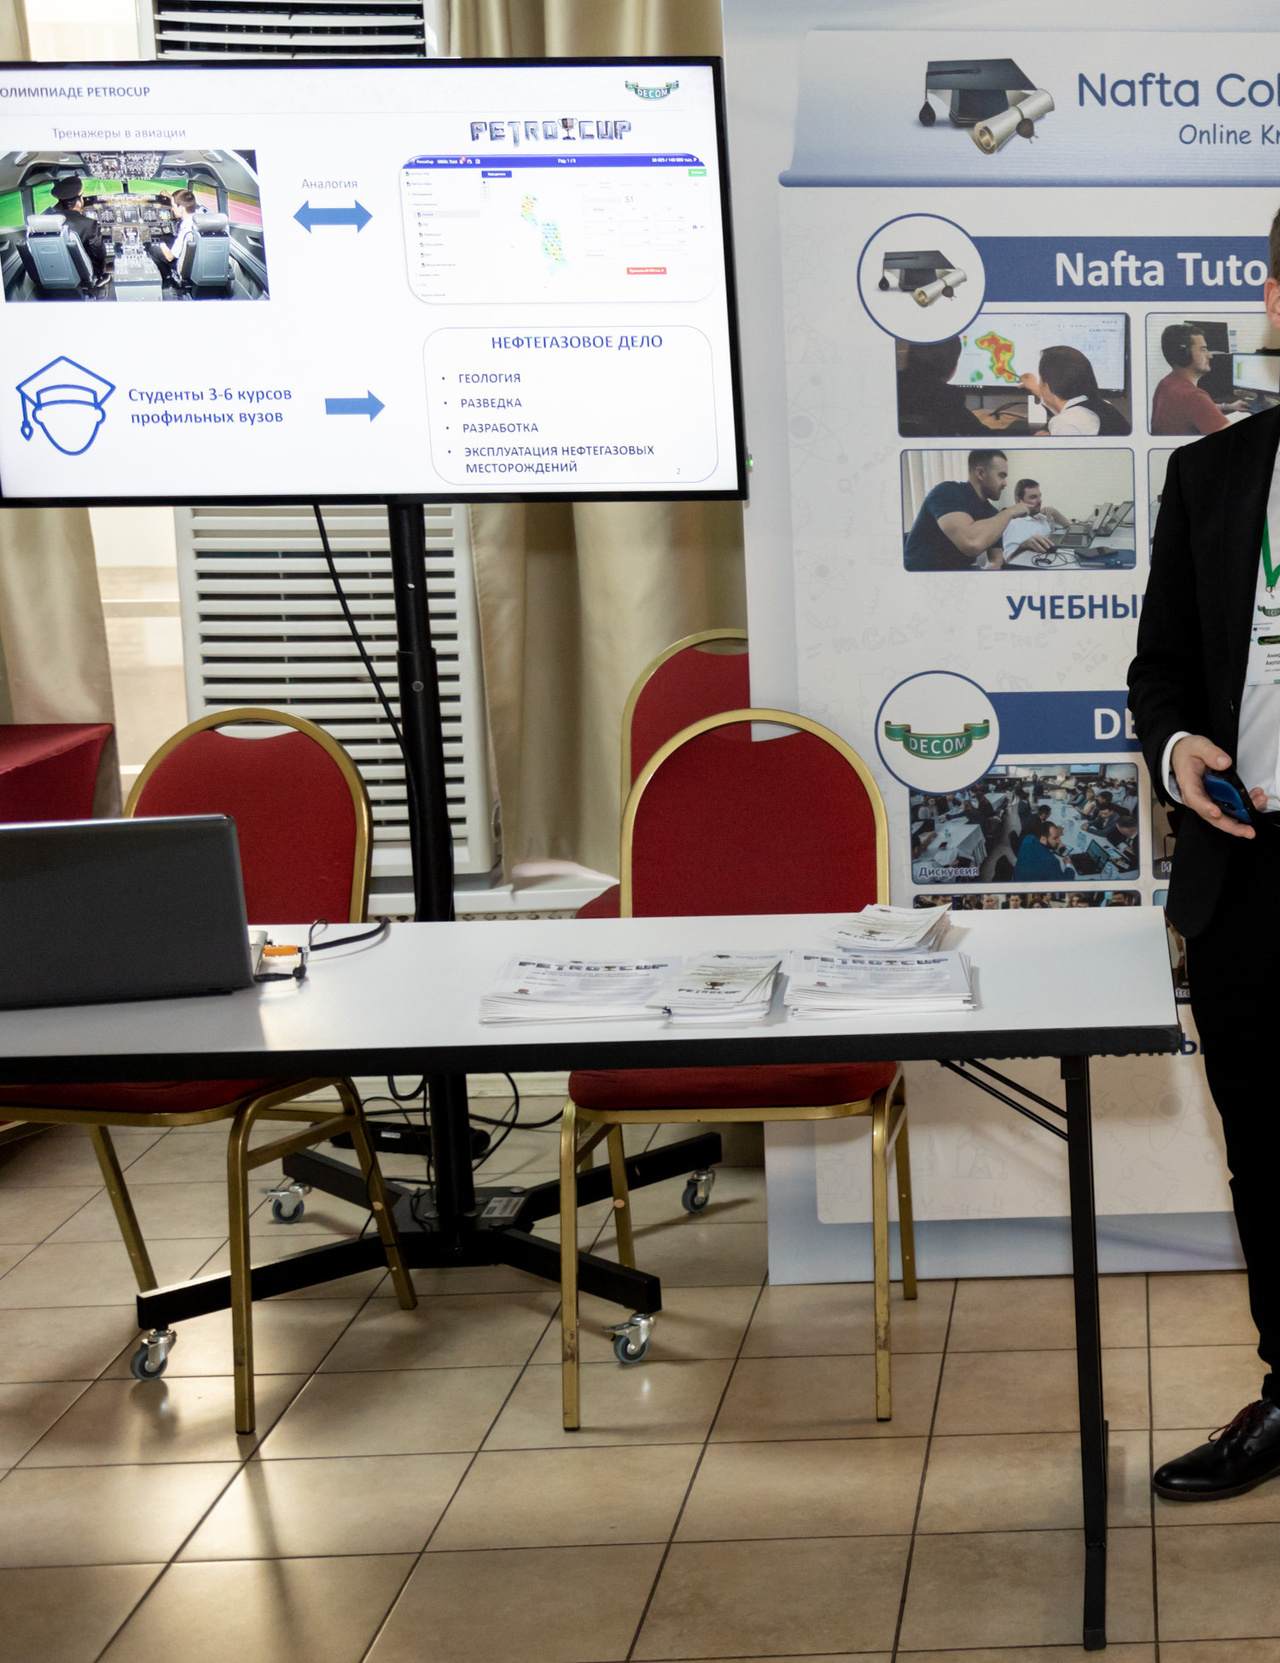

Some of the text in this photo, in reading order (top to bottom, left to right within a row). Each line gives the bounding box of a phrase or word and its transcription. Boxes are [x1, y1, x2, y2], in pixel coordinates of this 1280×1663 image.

[0, 86, 151, 99] ОЛИМПИАДЕ PETROCUP
[636, 86, 669, 100] DECOM
[1078, 72, 1200, 107] Nafta
[52, 127, 120, 140] Тренажеры
[134, 129, 186, 140] авиации
[1179, 123, 1253, 146] Online
[301, 178, 358, 190] Аналогия
[1055, 250, 1269, 287] Nafta Tuto
[491, 334, 663, 351] НЕФТЕГАЗОВОЕ ДЕЛО
[458, 372, 521, 384] ГЕОЛОГИЯ
[128, 388, 292, 405] Студенты 3-6 курсов
[461, 397, 522, 410] РАЗВЕДКА
[131, 409, 284, 427] профильных вузов
[463, 422, 539, 434] РАЗРАБОТКА
[465, 444, 655, 459] ЭКСПЛУАТАЦИЯ НЕФТЕГАЗОВЫХ
[466, 460, 578, 475] МЕСТОРОЖДЕНИЙ
[909, 736, 968, 755] DECOM
[918, 866, 979, 880] Дискуссия
